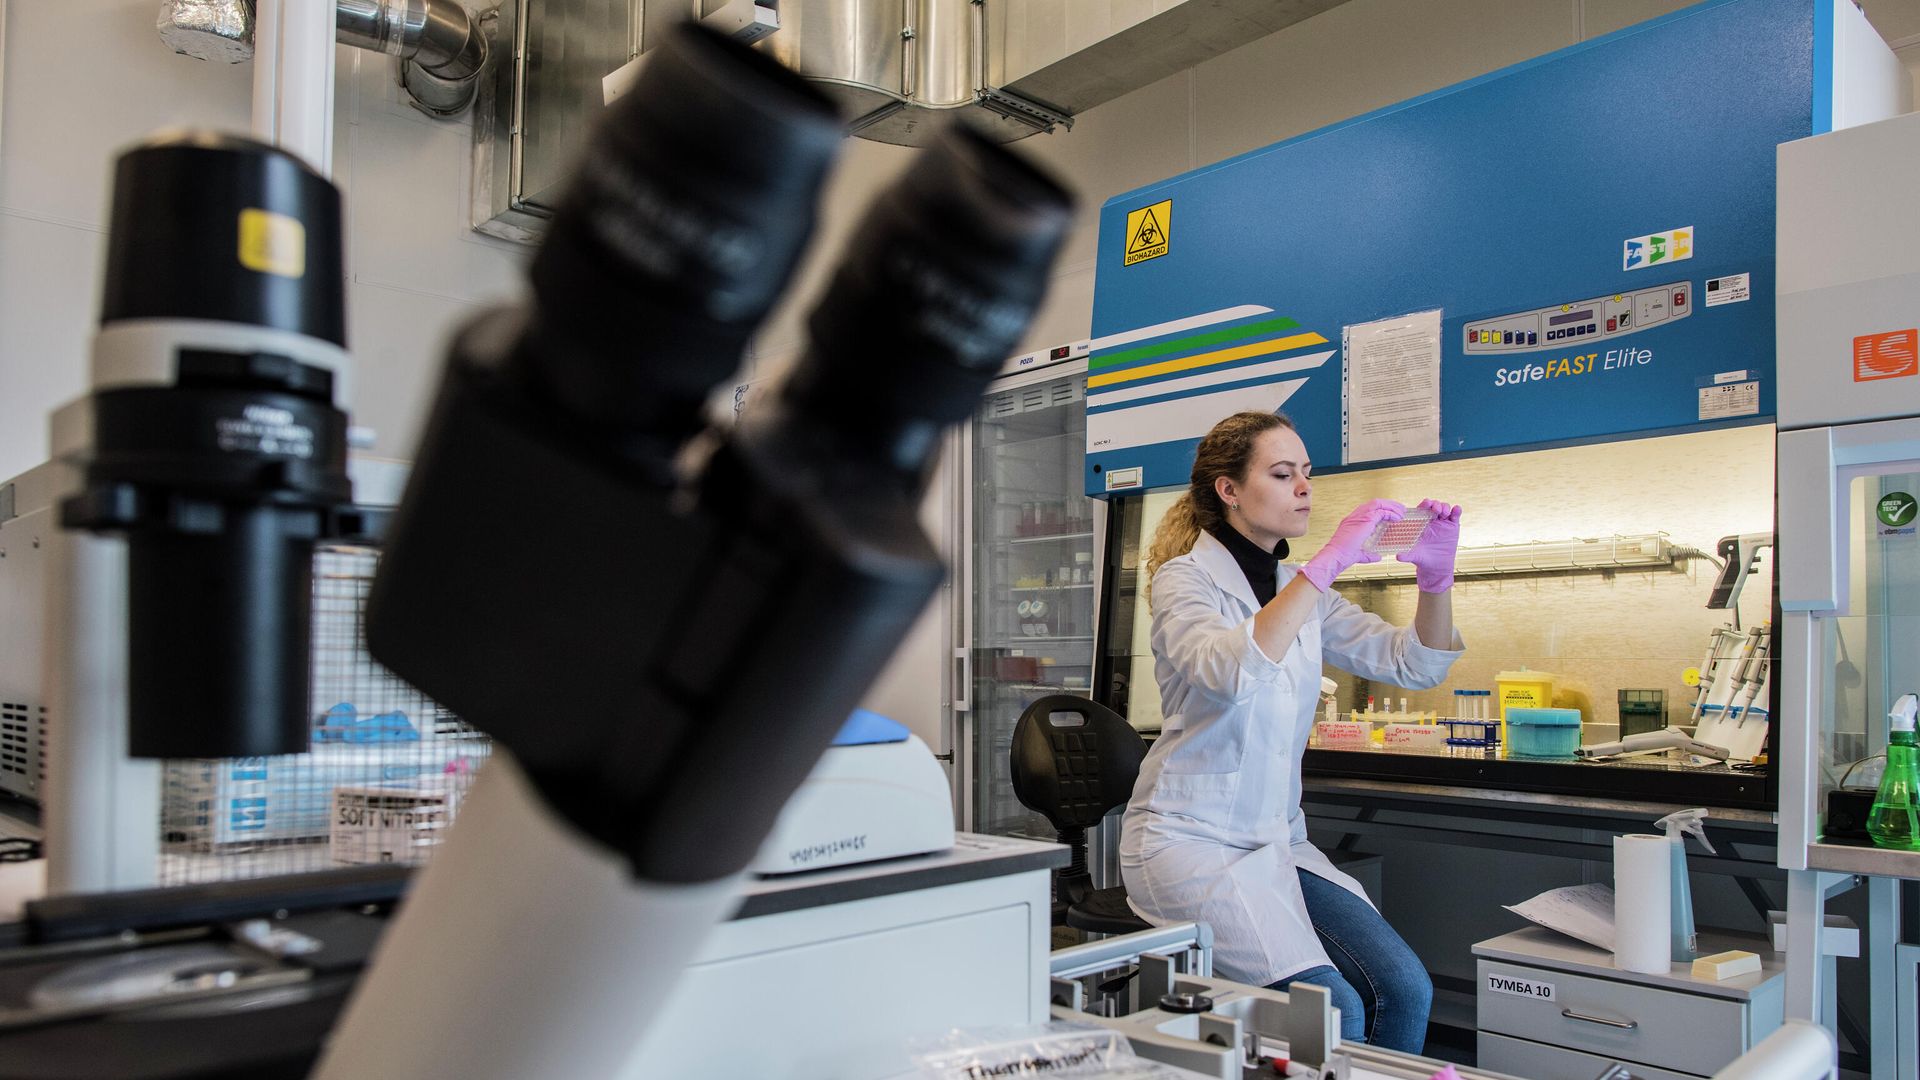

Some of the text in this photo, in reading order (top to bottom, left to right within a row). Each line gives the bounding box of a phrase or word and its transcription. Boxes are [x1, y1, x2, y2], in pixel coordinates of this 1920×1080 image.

[1127, 246, 1166, 263] BIOHAZARD
[1494, 347, 1653, 387] SafeFAST Elite
[338, 807, 376, 828] SOFT
[1489, 977, 1551, 998] ТУМБА 10
